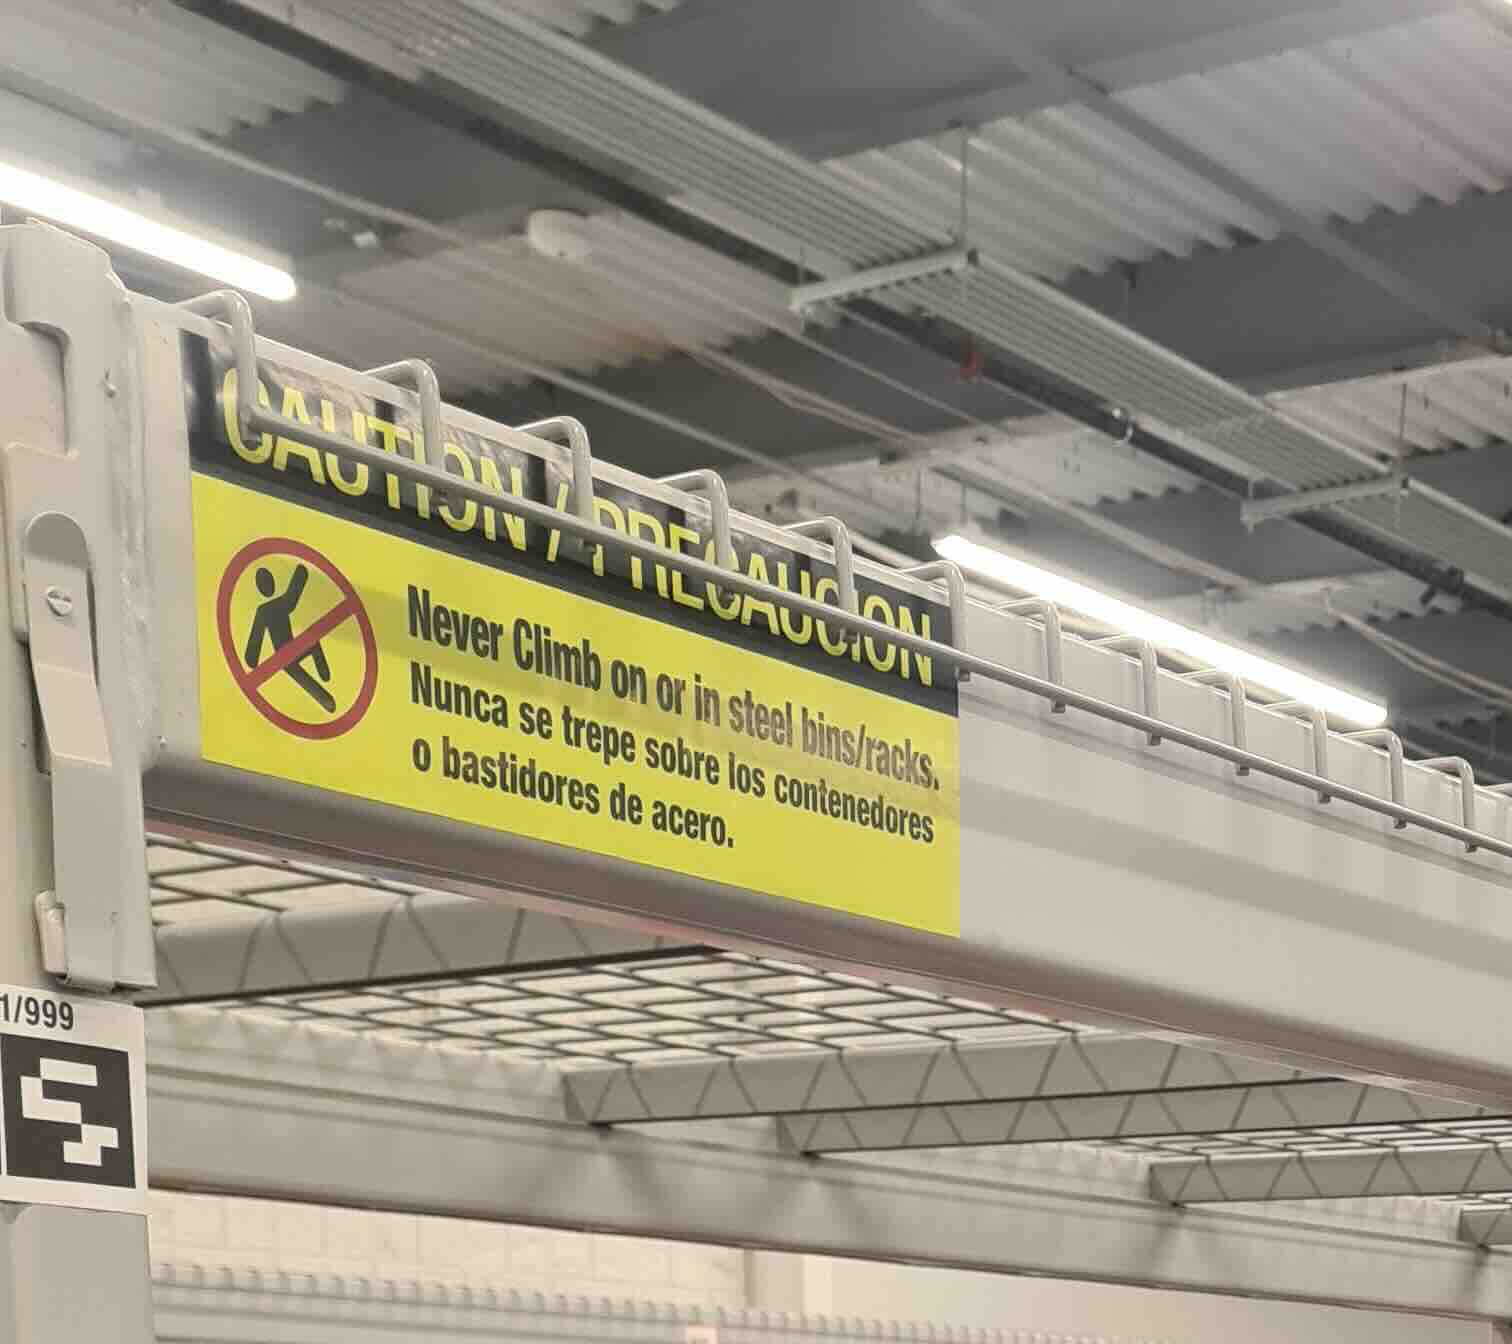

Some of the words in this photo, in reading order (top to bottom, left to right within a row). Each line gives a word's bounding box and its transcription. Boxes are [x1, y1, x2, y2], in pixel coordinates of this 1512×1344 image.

[408, 583, 503, 661] Never
[513, 618, 600, 691] Climb
[611, 659, 648, 704] on
[656, 672, 686, 715] or
[694, 673, 720, 727] in
[729, 690, 793, 748] steel
[801, 706, 939, 791] bins/racks.
[411, 660, 508, 729] Nunca
[519, 701, 552, 739] se
[562, 705, 635, 765] trepe
[645, 735, 720, 785] sobre
[728, 752, 766, 798] los
[774, 773, 934, 843] contenedores
[412, 738, 431, 773] o
[442, 735, 600, 815] bastidores
[610, 782, 643, 825] de
[652, 799, 734, 848] acero.
